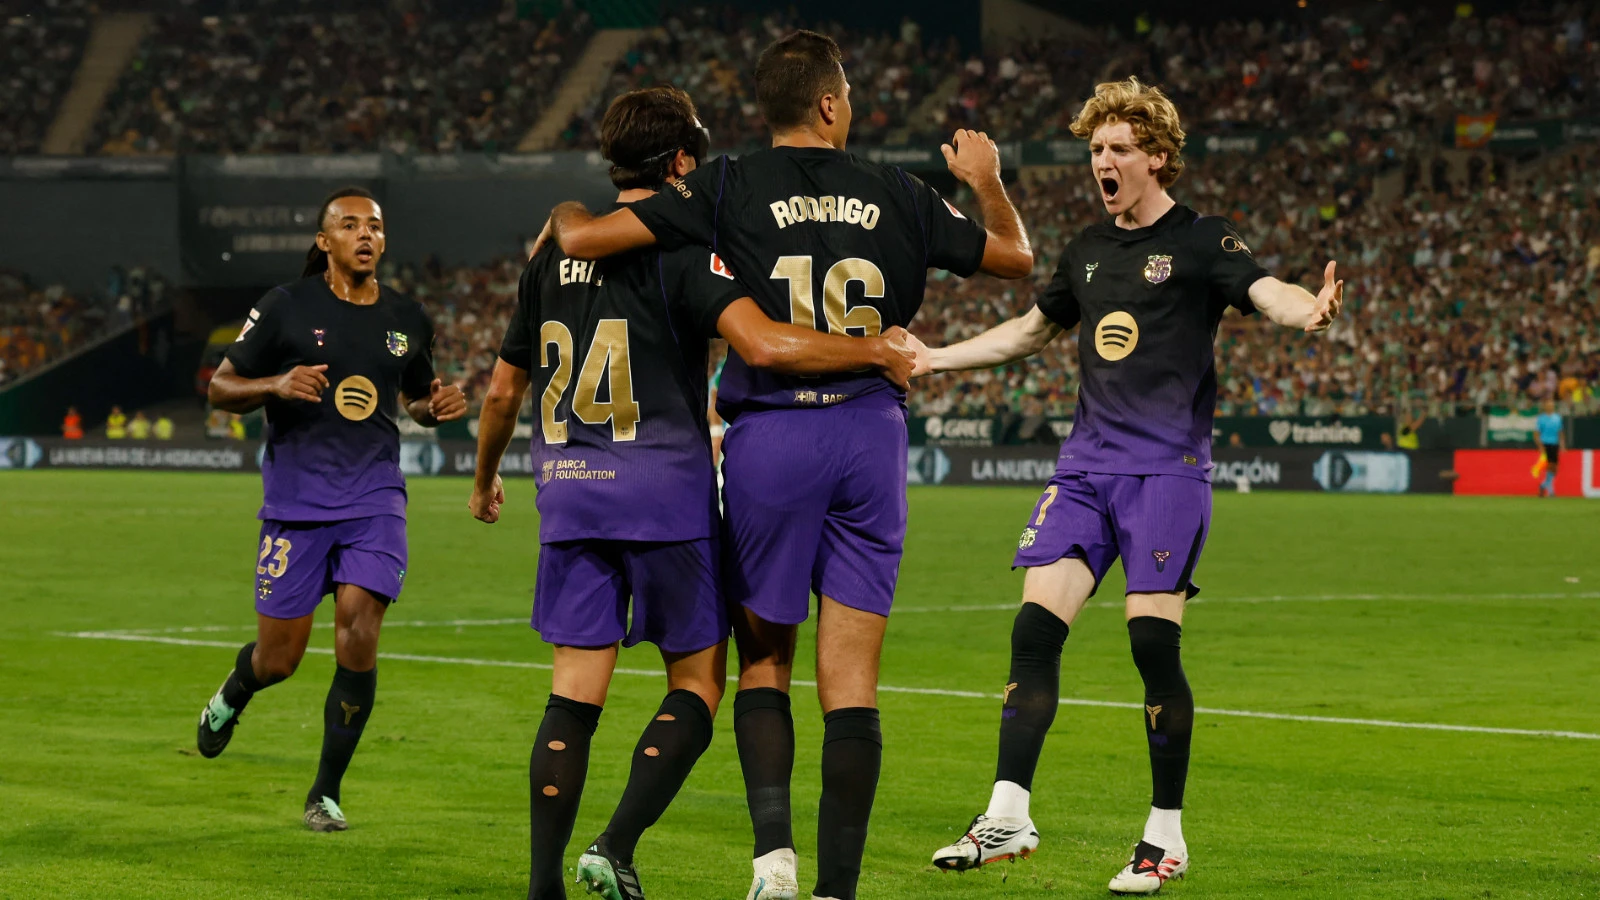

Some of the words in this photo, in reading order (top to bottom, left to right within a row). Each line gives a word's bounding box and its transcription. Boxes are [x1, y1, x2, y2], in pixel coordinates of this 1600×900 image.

[672, 177, 693, 199] dea
[769, 195, 880, 230] RODRIGO
[559, 258, 604, 286] ERI
[769, 255, 885, 338] 16
[540, 319, 640, 444] 24
[822, 393, 854, 404] BAR
[555, 470, 616, 480] FOUNDATION
[556, 460, 586, 470] BARÇA
[971, 459, 994, 480] LA
[1212, 457, 1281, 483] TACIÓN
[1035, 485, 1058, 526] 7
[256, 535, 292, 578] 23
